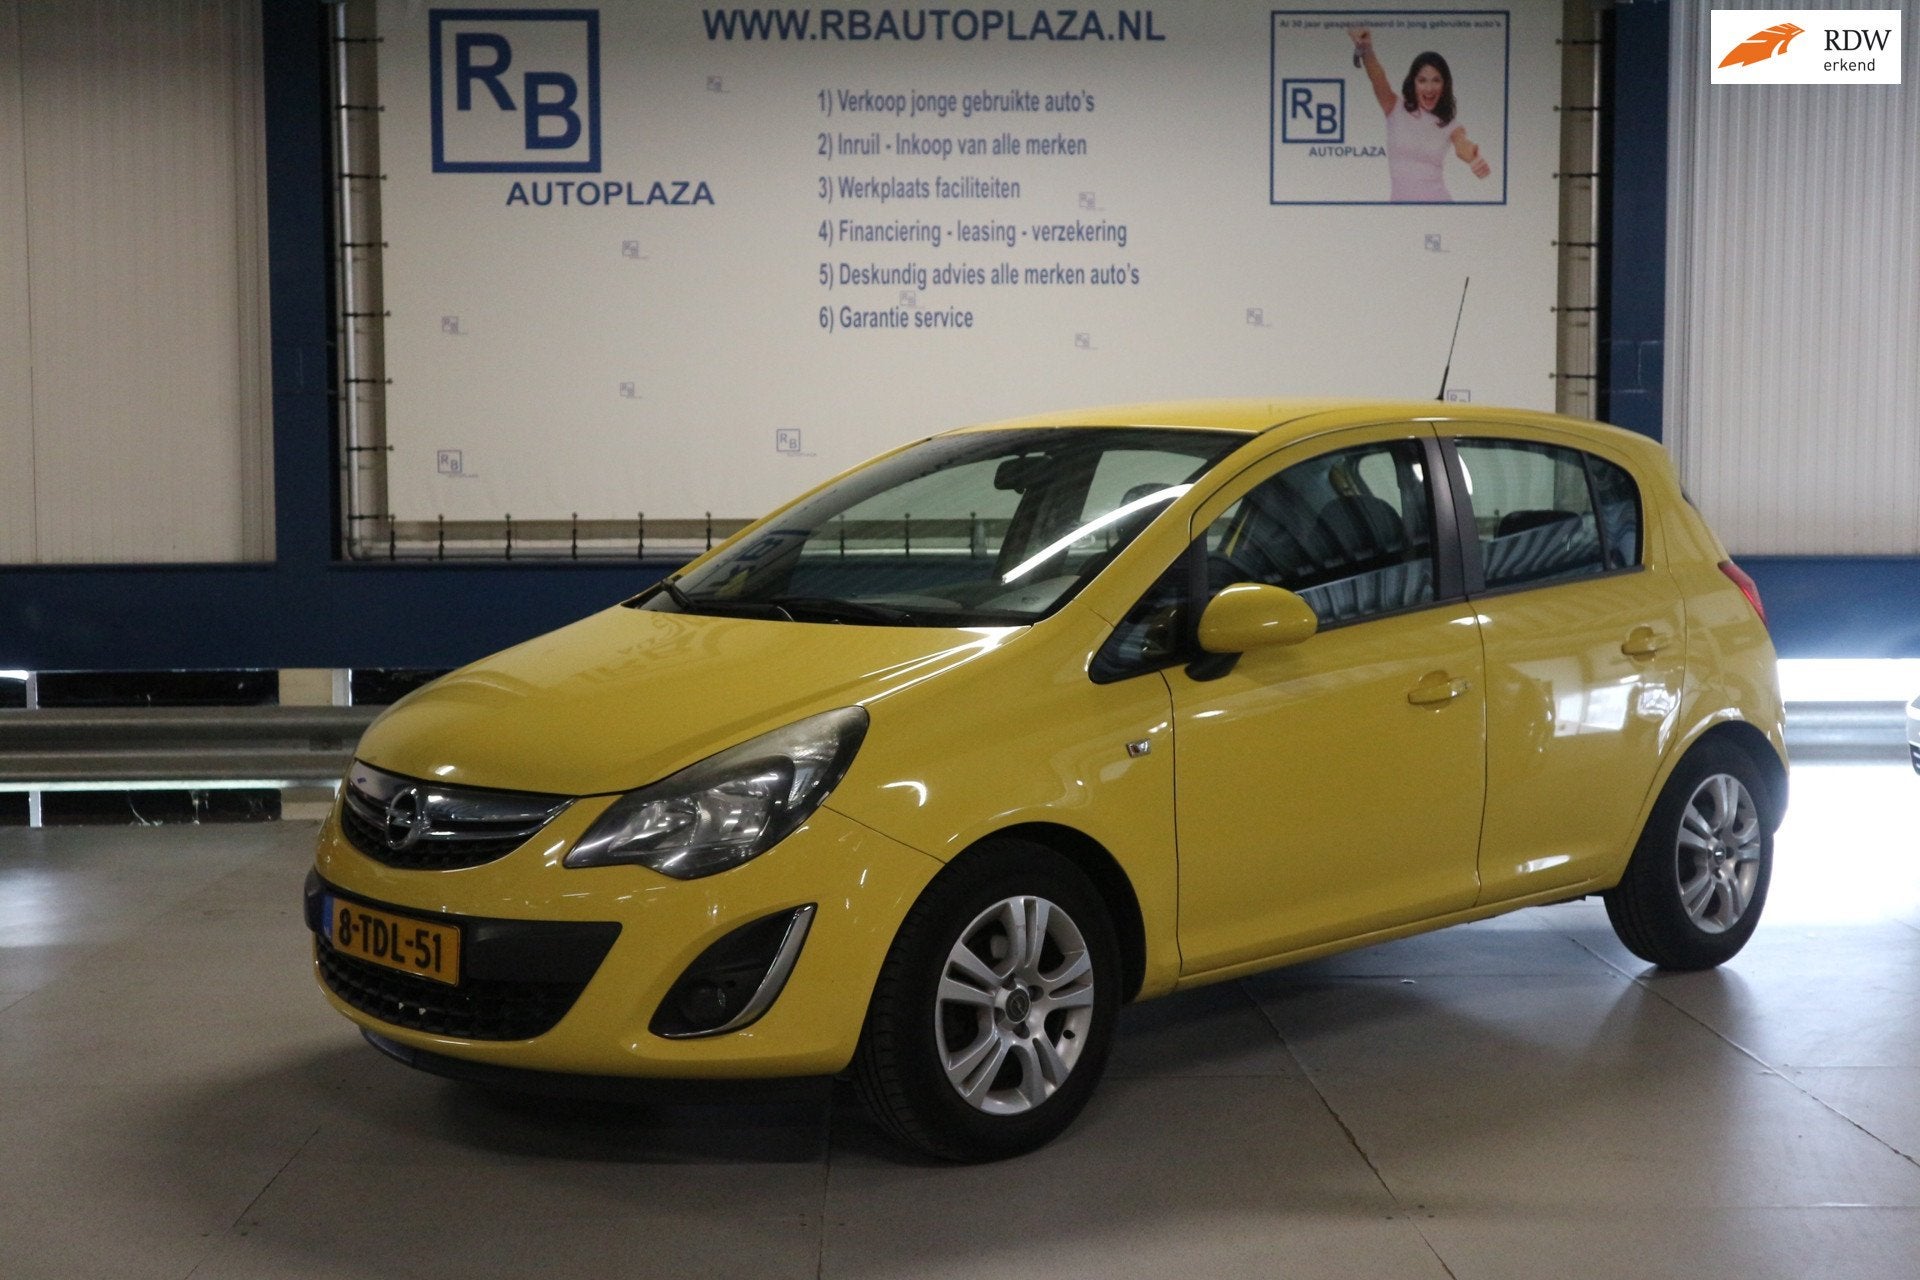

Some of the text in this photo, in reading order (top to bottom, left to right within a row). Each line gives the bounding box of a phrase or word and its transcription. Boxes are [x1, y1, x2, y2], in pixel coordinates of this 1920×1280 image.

[702, 8, 1167, 42] WWW.RBAUTOPLAZA.NL
[455, 32, 582, 150] RB
[818, 90, 1095, 118] 1) Verkoop jonge gebruikte auto's
[1291, 87, 1338, 135] RB
[818, 133, 833, 160] 2)
[838, 133, 880, 156] Inruil
[896, 133, 953, 161] Inkoop
[957, 138, 987, 156] van
[992, 133, 1021, 156] alle
[1025, 133, 1087, 156] merken
[1307, 146, 1387, 158] AUTOPLAZA
[505, 181, 716, 207] AUTOPLAZA
[818, 176, 1021, 204] 3) Werkplaats faciliteiten
[818, 220, 834, 247] 4)
[838, 220, 942, 248] Financiering
[957, 220, 1017, 248] leasing
[1031, 220, 1128, 248] verzekering
[819, 263, 1140, 292] 5) Deskundig advies alle merken auto's
[819, 306, 974, 334] 6) Garantie service
[338, 908, 442, 973] 8-TDL-51
